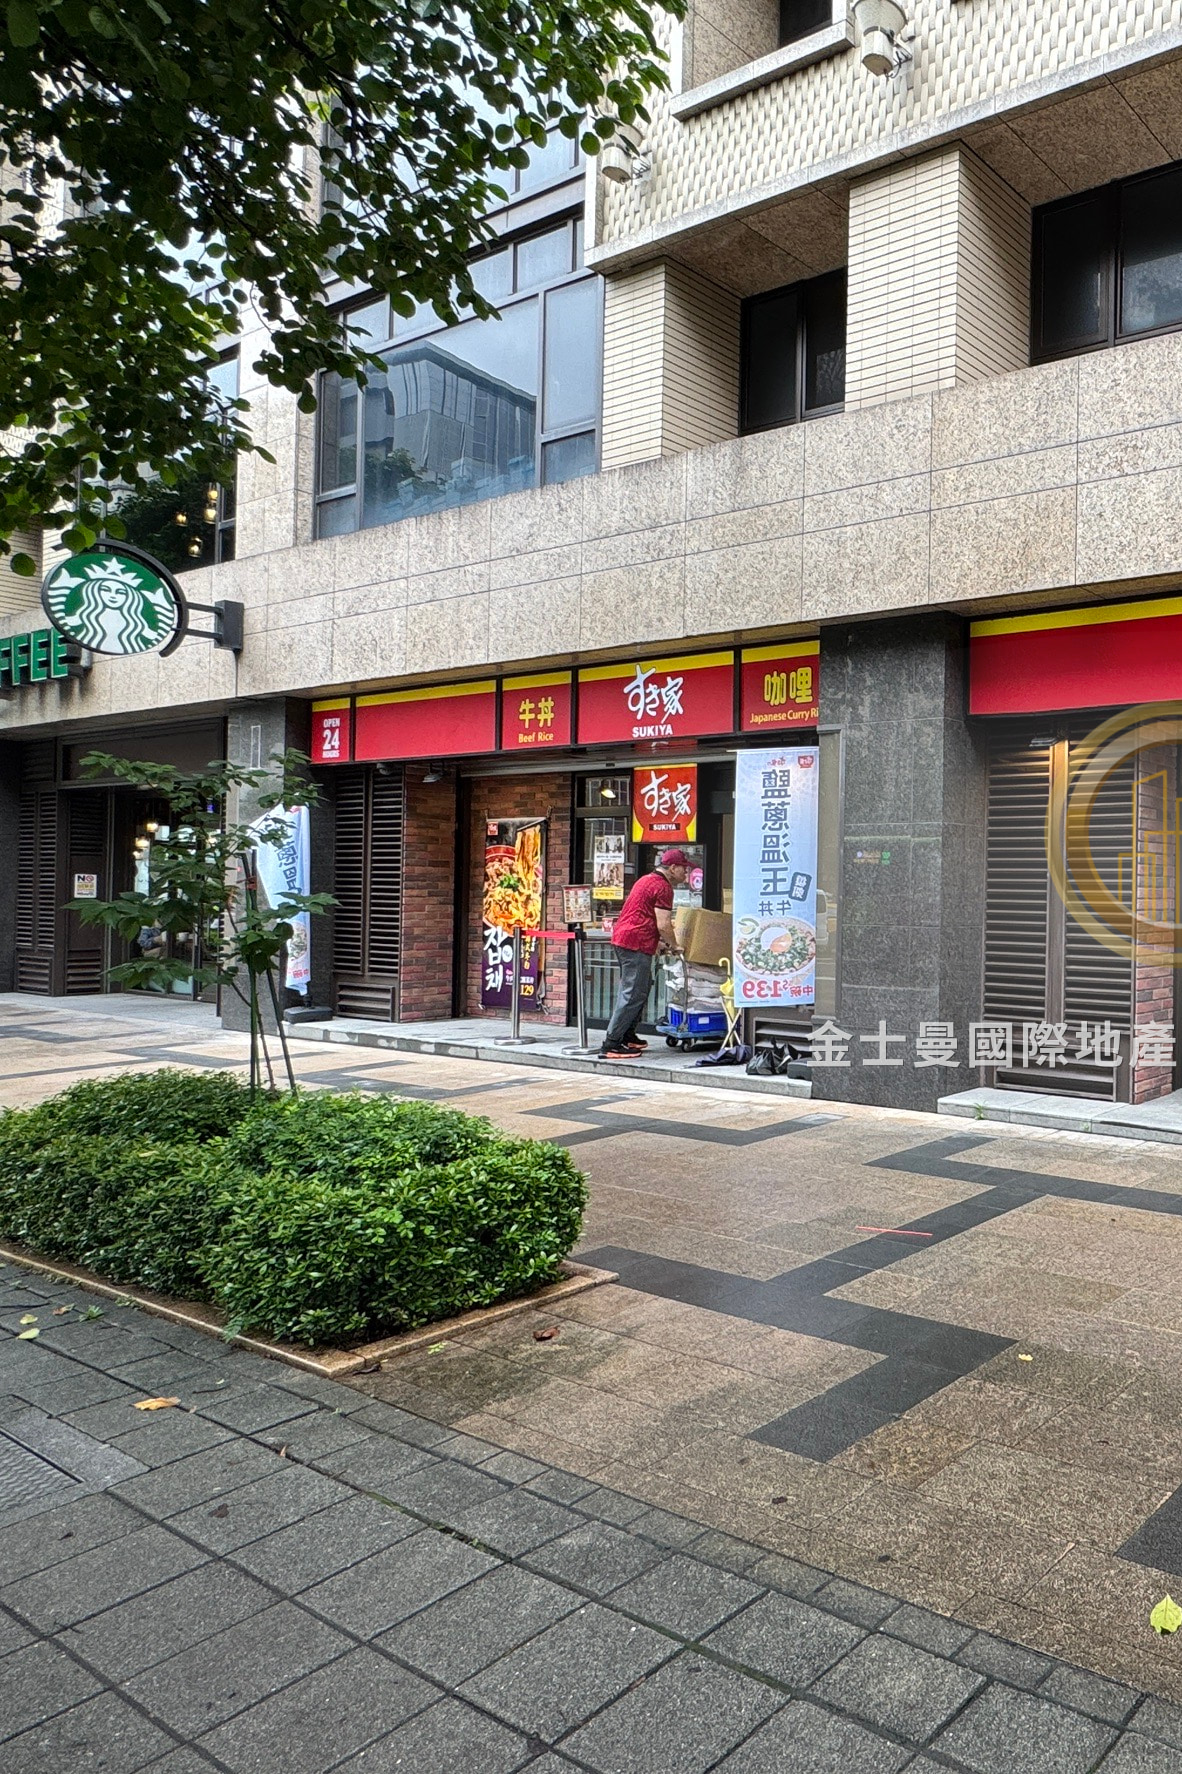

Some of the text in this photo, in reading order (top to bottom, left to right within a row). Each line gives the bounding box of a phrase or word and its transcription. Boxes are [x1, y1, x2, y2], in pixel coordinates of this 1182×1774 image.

[623, 664, 684, 724] すき家
[764, 667, 813, 706] 咖哩
[519, 696, 555, 728] 牛丼
[750, 713, 787, 725] Japanese
[787, 709, 810, 721] Curry
[323, 718, 340, 728] OPEN
[632, 724, 673, 738] SUKIYA
[322, 728, 340, 749] 24
[518, 731, 554, 743] Beef Rice
[641, 770, 691, 821] すき家
[653, 823, 677, 831] SUKIYA
